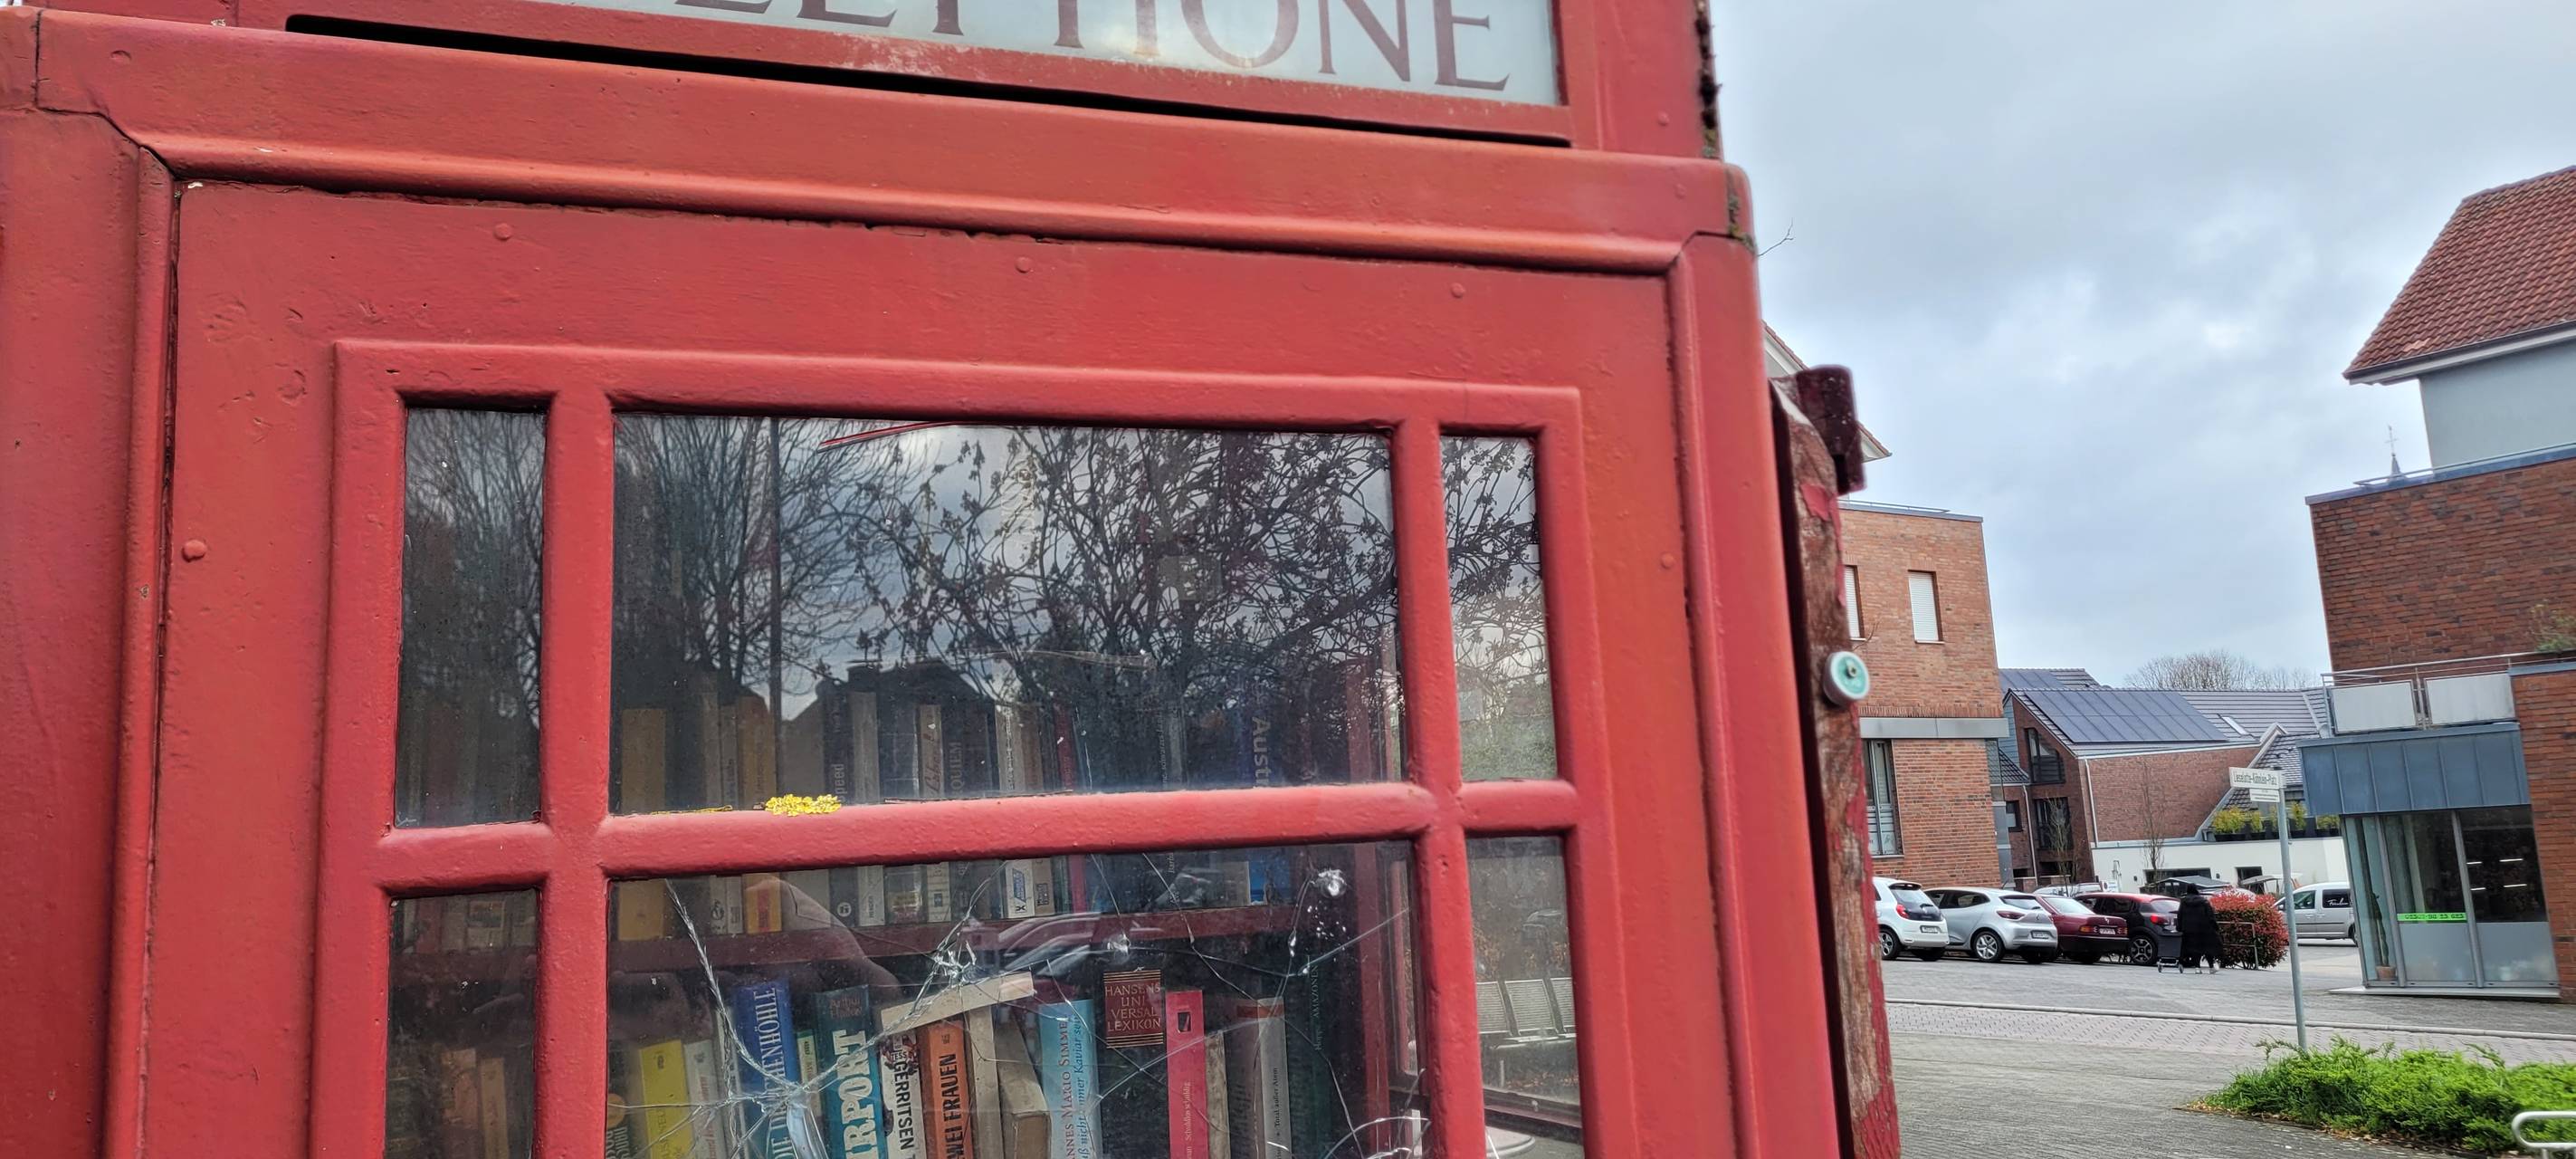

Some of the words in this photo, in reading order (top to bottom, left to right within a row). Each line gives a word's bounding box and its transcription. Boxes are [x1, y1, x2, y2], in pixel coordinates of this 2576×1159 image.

[1104, 982, 1161, 997] HANSENS
[1121, 995, 1146, 1007] UNI
[1110, 1006, 1158, 1020] VERSAL
[1106, 1018, 1160, 1032] LEXIKON
[1072, 1039, 1084, 1074] Kaviar
[939, 1053, 962, 1122] FRAUEN
[892, 1060, 915, 1151] GERRITSEN
[1076, 1116, 1089, 1146] nicht
